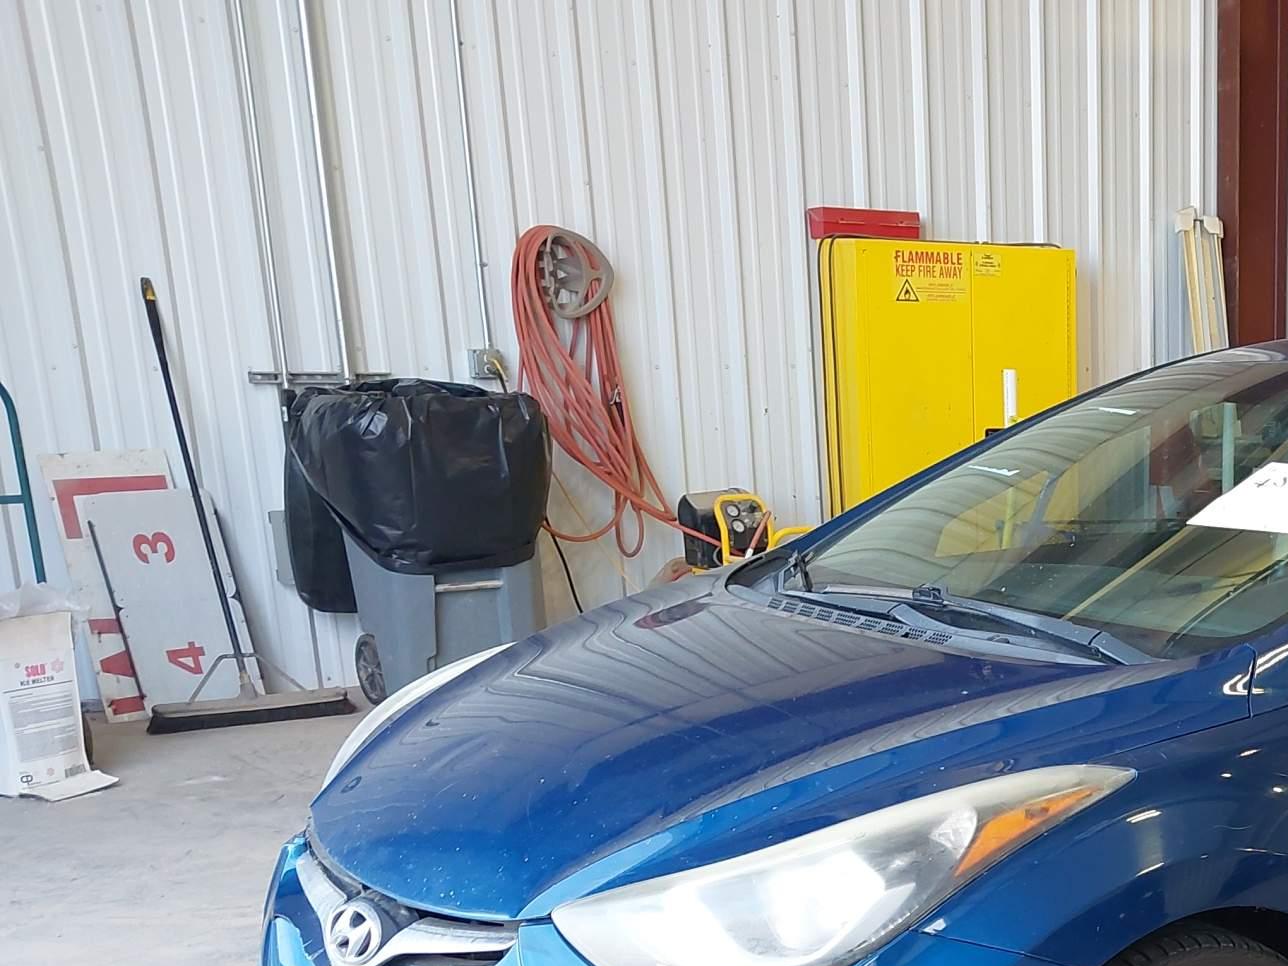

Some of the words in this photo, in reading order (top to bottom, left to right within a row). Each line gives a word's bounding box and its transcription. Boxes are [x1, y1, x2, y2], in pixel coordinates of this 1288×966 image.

[895, 250, 964, 265] FLAMMABLE
[895, 264, 916, 277] KEEP
[918, 265, 937, 278] FIRE
[939, 266, 963, 279] AWAY
[132, 531, 176, 564] 3
[166, 641, 206, 675] 4
